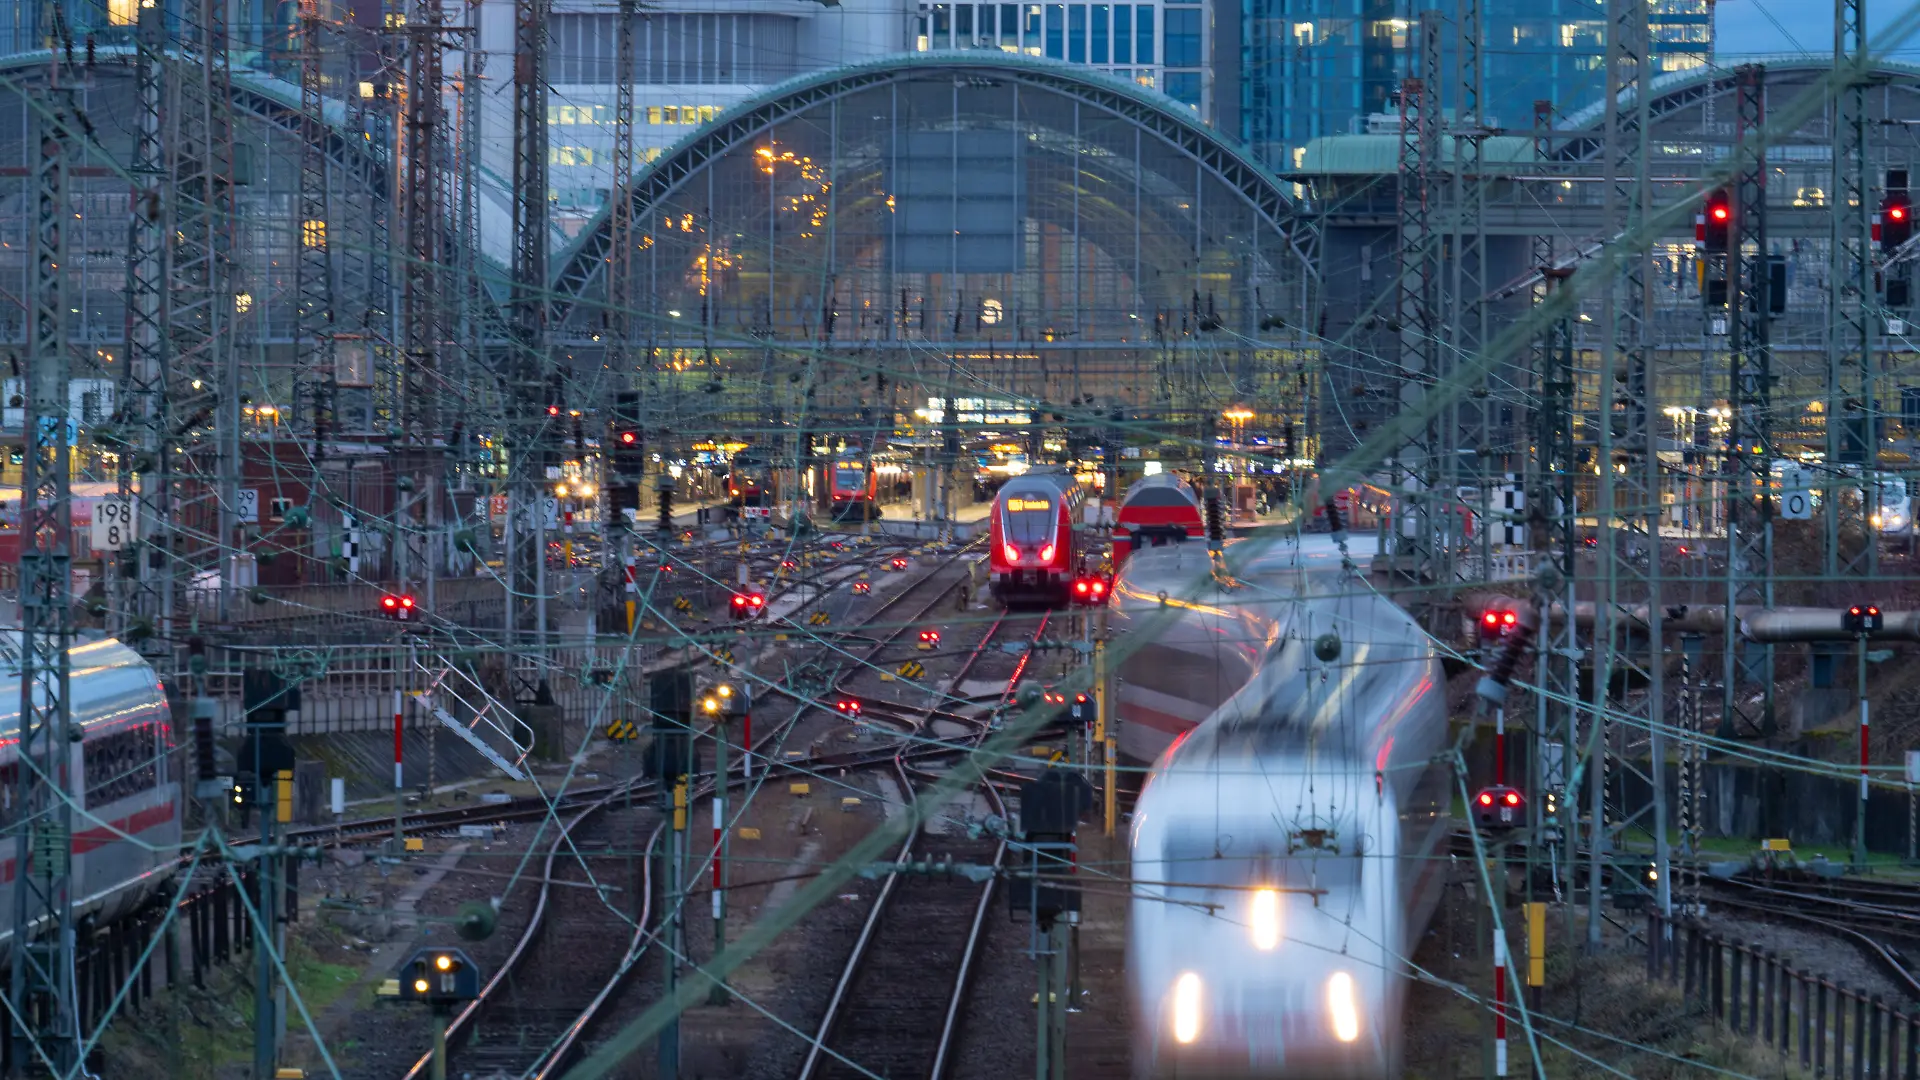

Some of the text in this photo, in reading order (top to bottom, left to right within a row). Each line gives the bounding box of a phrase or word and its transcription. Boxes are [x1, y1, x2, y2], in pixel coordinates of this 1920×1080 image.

[238, 491, 255, 505] 99
[1789, 495, 1804, 514] 0
[96, 503, 132, 524] 198
[107, 525, 121, 545] 8
